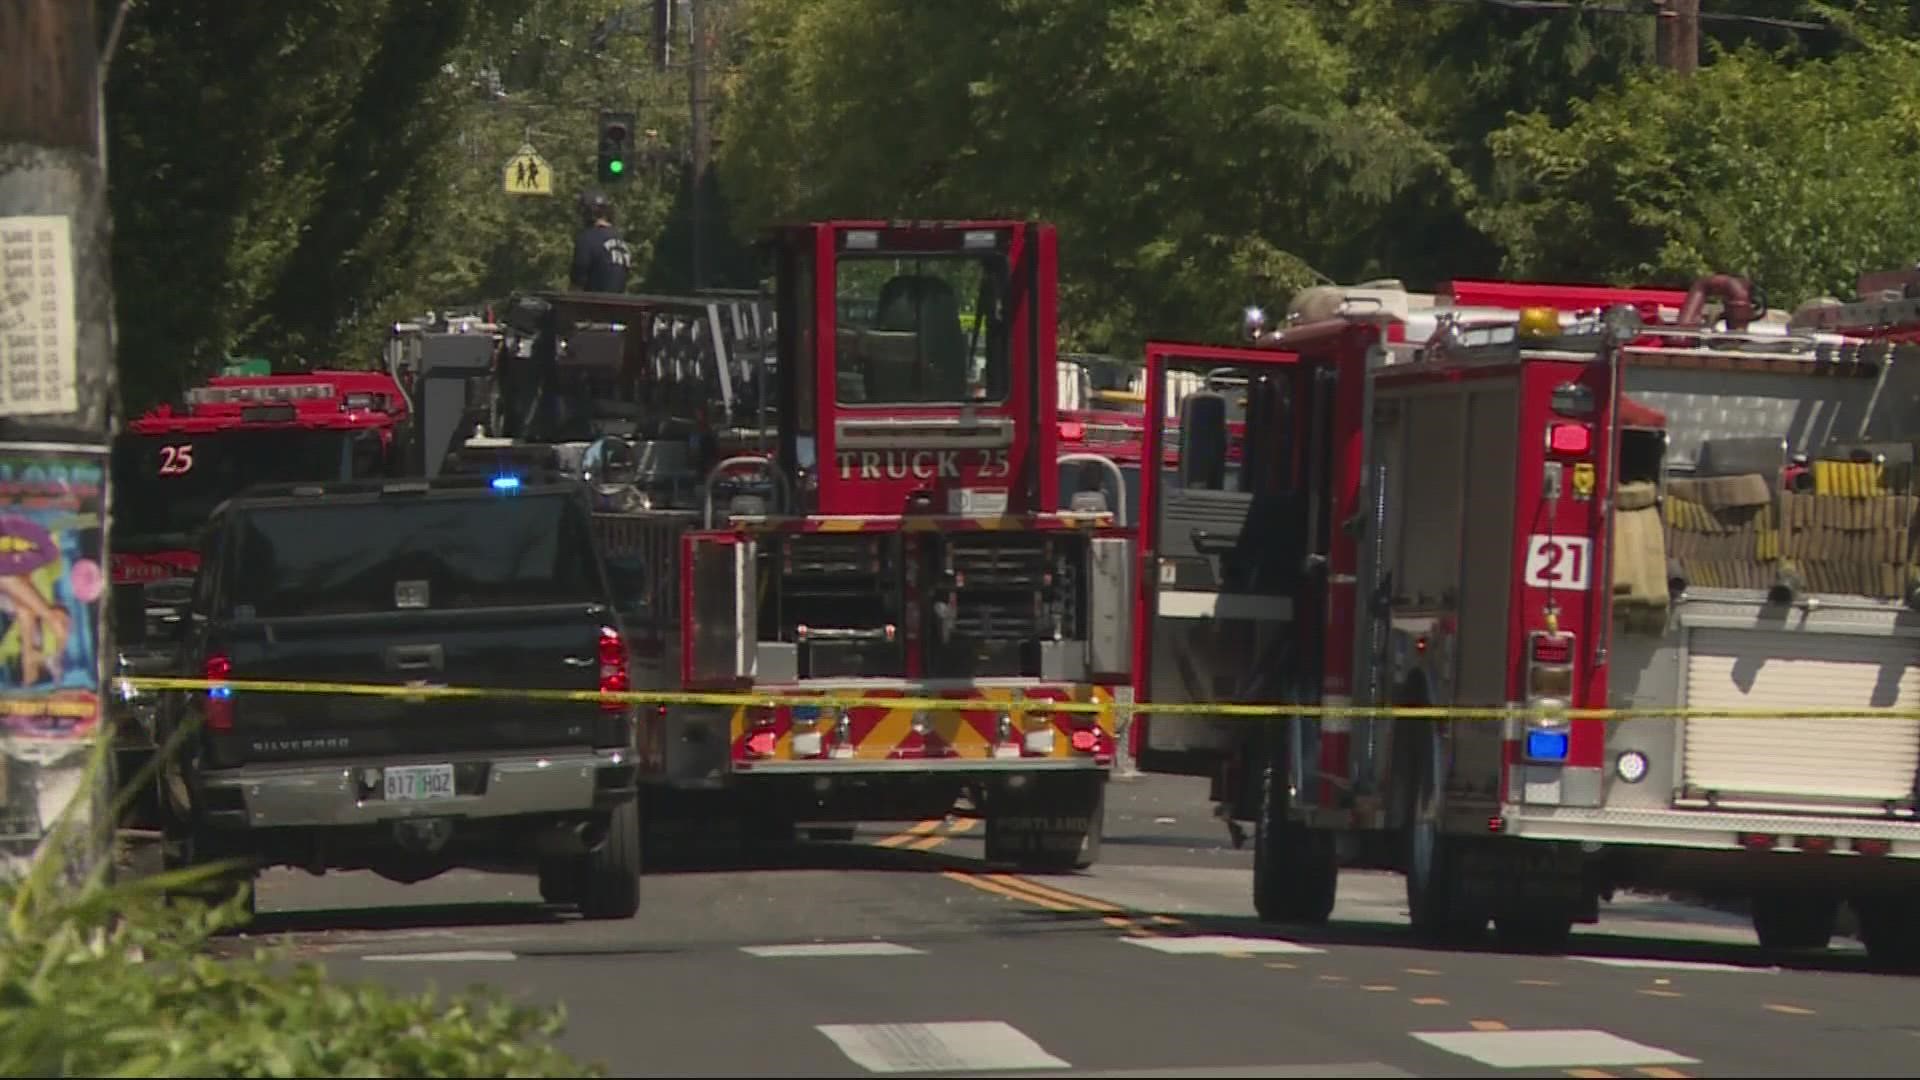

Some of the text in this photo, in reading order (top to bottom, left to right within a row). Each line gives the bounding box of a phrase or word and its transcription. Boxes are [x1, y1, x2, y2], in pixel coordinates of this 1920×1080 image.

[159, 444, 193, 474] 25
[837, 449, 1010, 479] TRUCK 25
[1536, 542, 1583, 582] 21
[386, 773, 415, 795] 817
